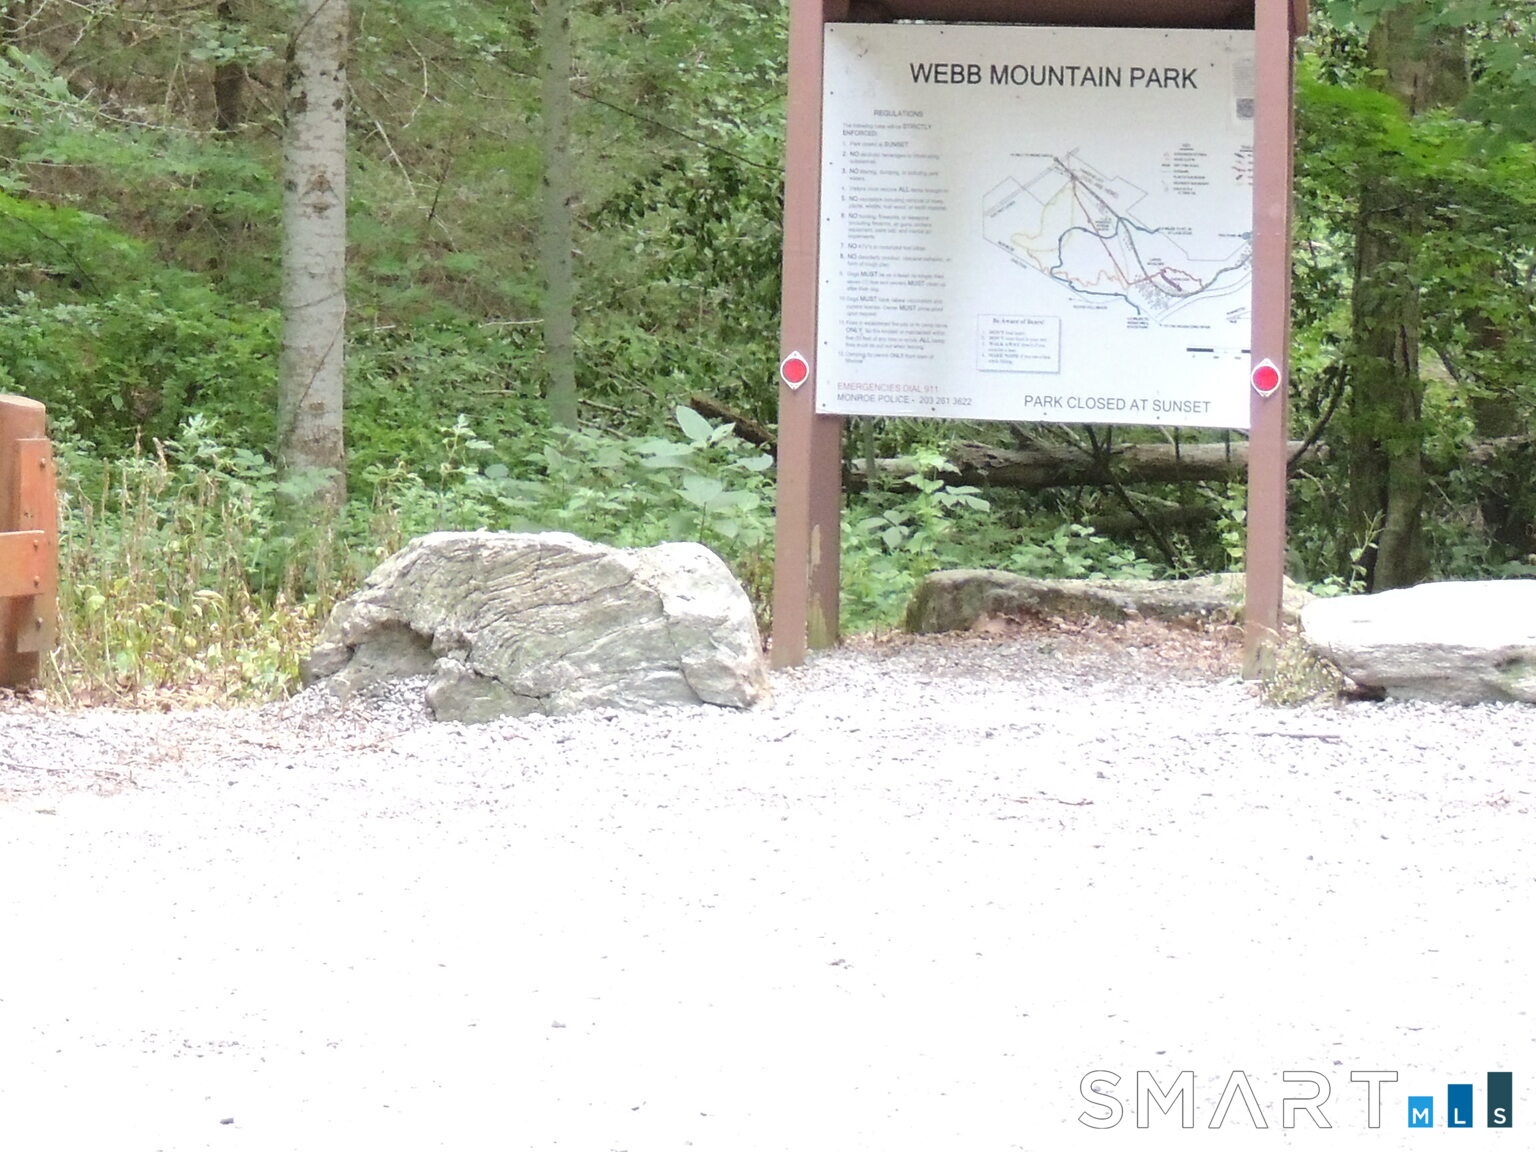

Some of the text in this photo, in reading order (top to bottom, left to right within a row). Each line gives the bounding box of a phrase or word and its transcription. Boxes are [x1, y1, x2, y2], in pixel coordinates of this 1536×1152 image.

[910, 63, 1198, 89] WEBB MOUNTAIN PARK
[873, 109, 924, 118] REGULATIONS
[837, 382, 939, 393] EMERGENCIES DIAL 911
[837, 393, 875, 402] MONROE
[878, 395, 909, 403] POLICE
[919, 396, 934, 405] 203
[952, 397, 973, 406] 3622
[1024, 395, 1211, 413] PARK CLOSED AT SUNSET
